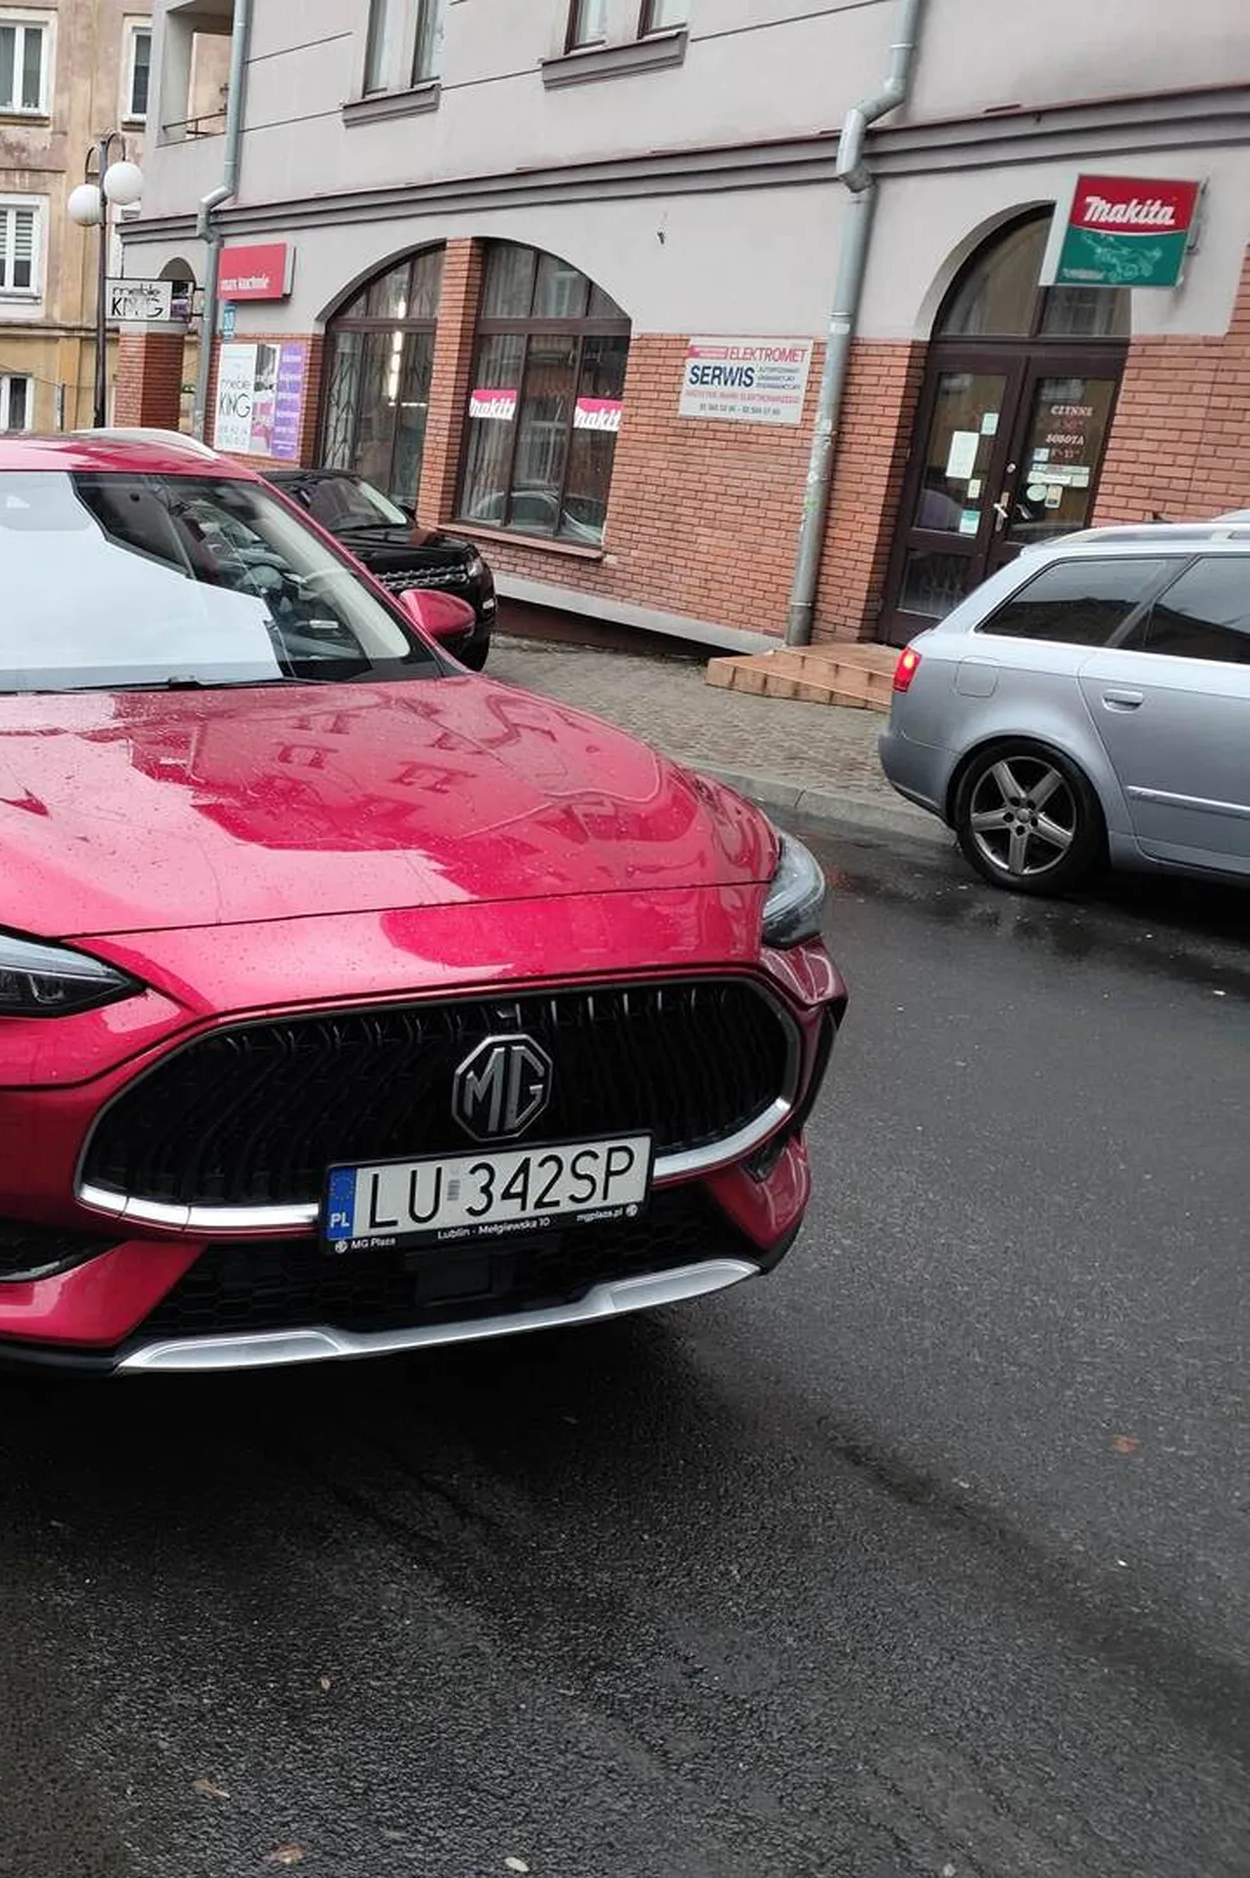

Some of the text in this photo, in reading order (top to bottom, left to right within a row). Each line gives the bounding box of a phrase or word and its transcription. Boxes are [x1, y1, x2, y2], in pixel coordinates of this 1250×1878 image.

[1083, 195, 1176, 226] Makita
[730, 346, 808, 363] ELEKTROMET
[689, 364, 756, 388] SERWIS
[462, 1044, 546, 1133] MG
[369, 1145, 635, 1229] LU 342SP
[330, 1211, 350, 1228] PL
[437, 1226, 471, 1240] Lublin
